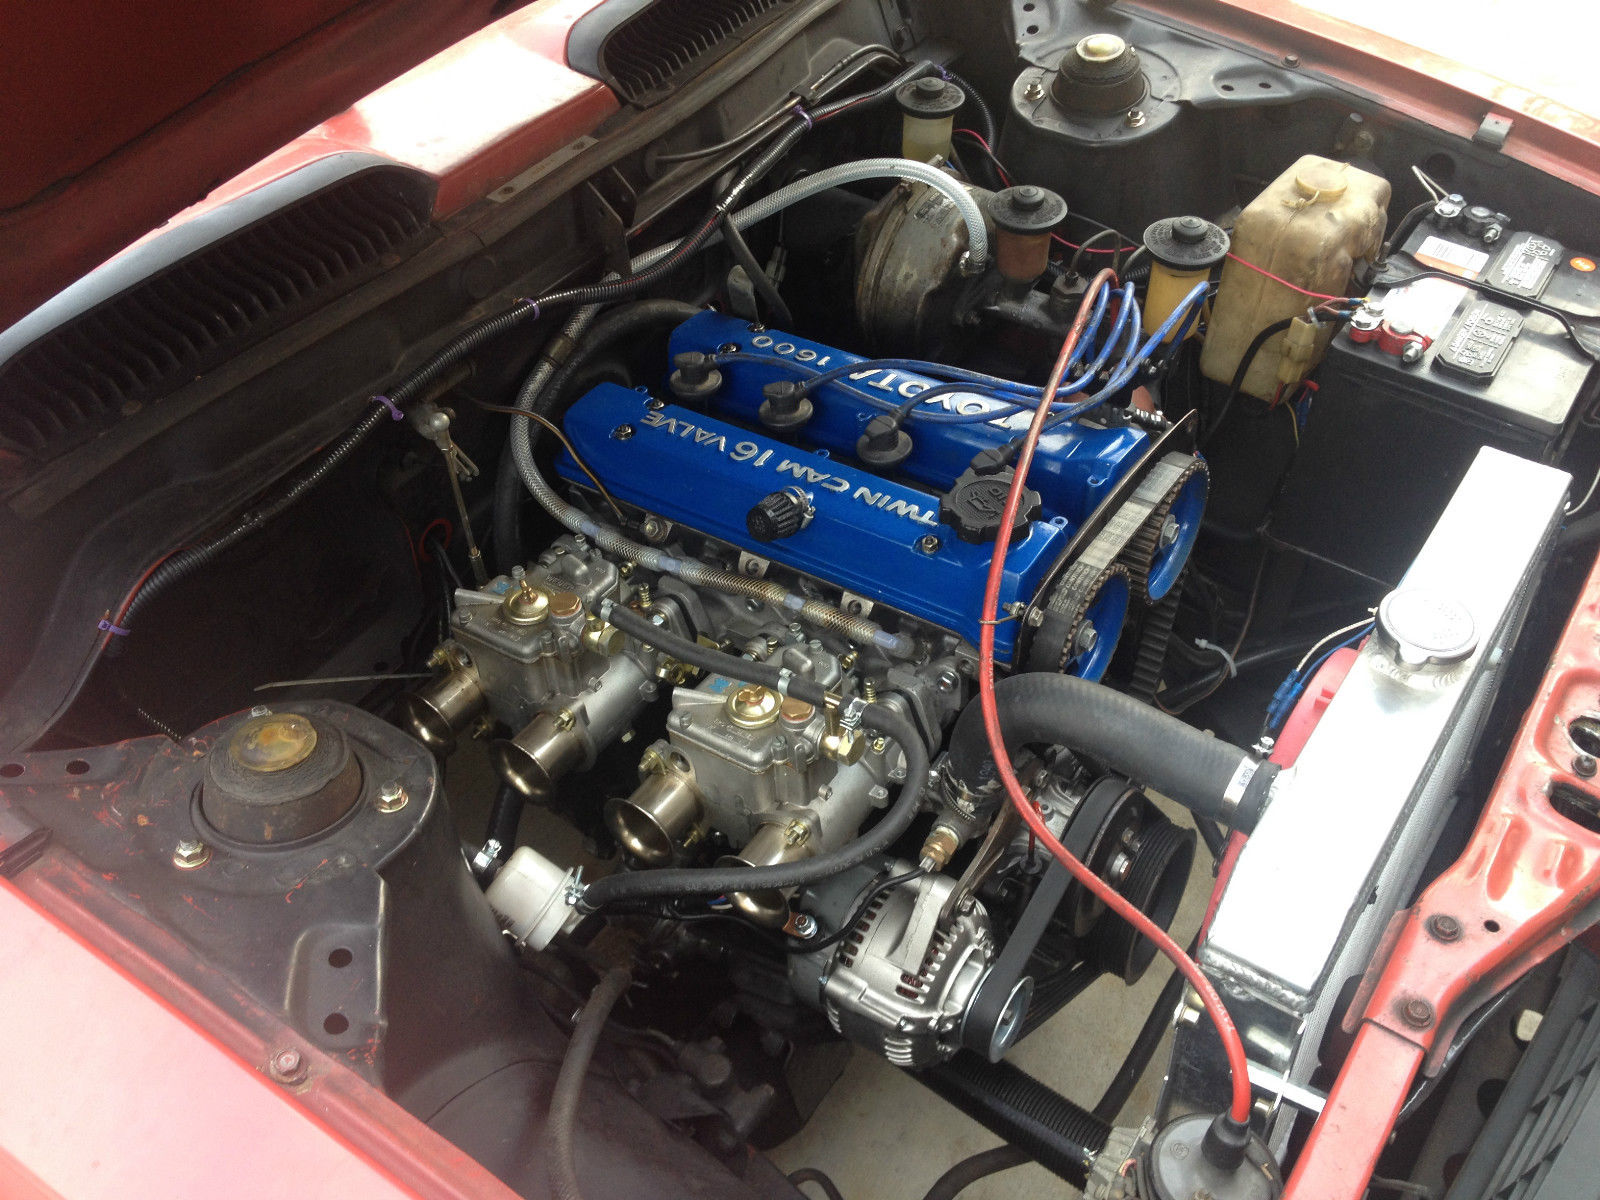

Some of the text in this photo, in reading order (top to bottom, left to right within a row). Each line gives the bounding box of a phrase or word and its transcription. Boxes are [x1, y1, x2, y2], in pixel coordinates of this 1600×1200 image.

[751, 335, 831, 366] 1600
[640, 410, 939, 527] TWIN CAM 16 VALVE
